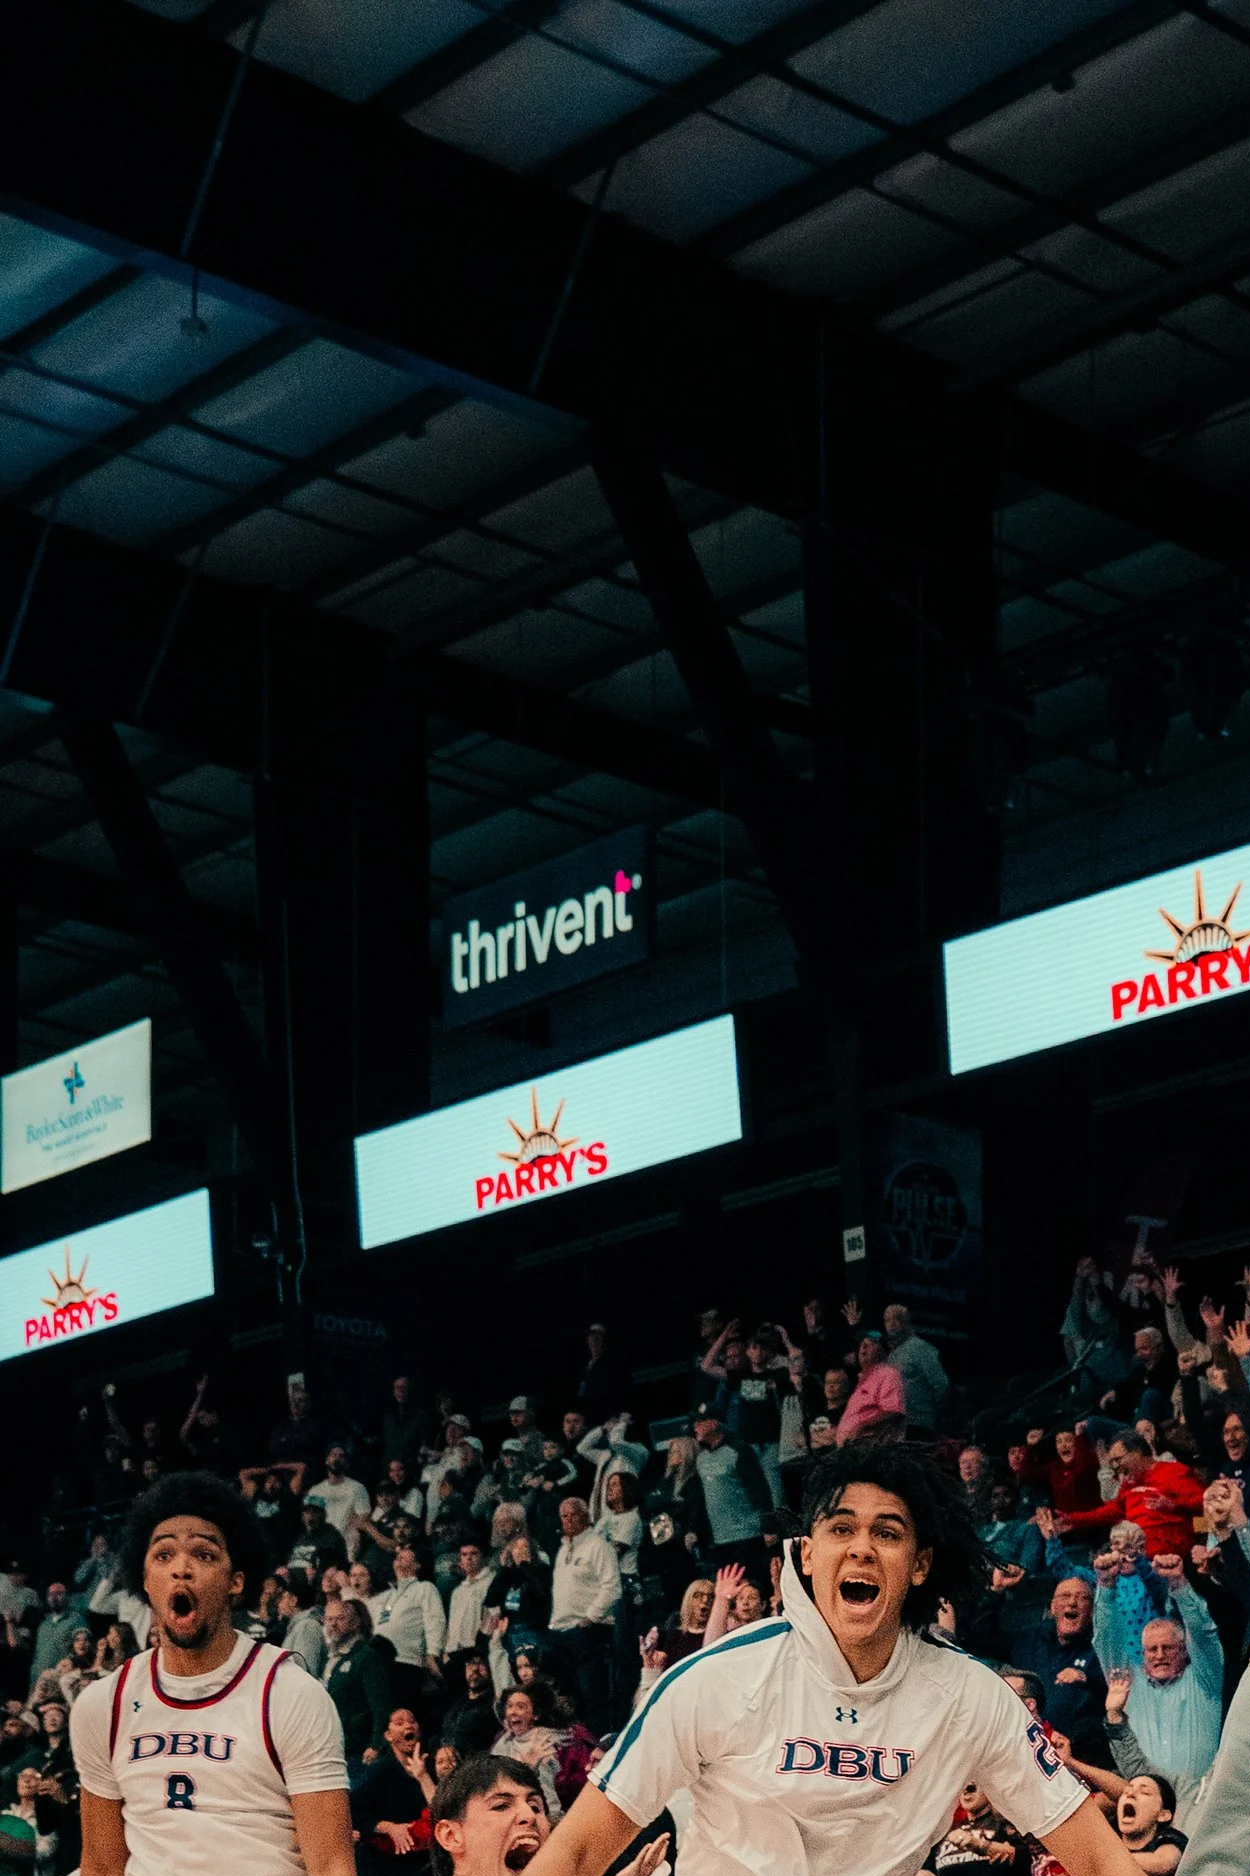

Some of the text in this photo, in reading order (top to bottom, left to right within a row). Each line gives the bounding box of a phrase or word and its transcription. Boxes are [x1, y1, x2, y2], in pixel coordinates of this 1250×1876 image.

[451, 870, 634, 994] thrivent
[475, 1141, 608, 1209] PARRY'S
[312, 1312, 388, 1340] TOYOTA
[128, 1731, 238, 1764] DBU
[776, 1736, 915, 1786] DBU
[164, 1771, 197, 1811] 8
